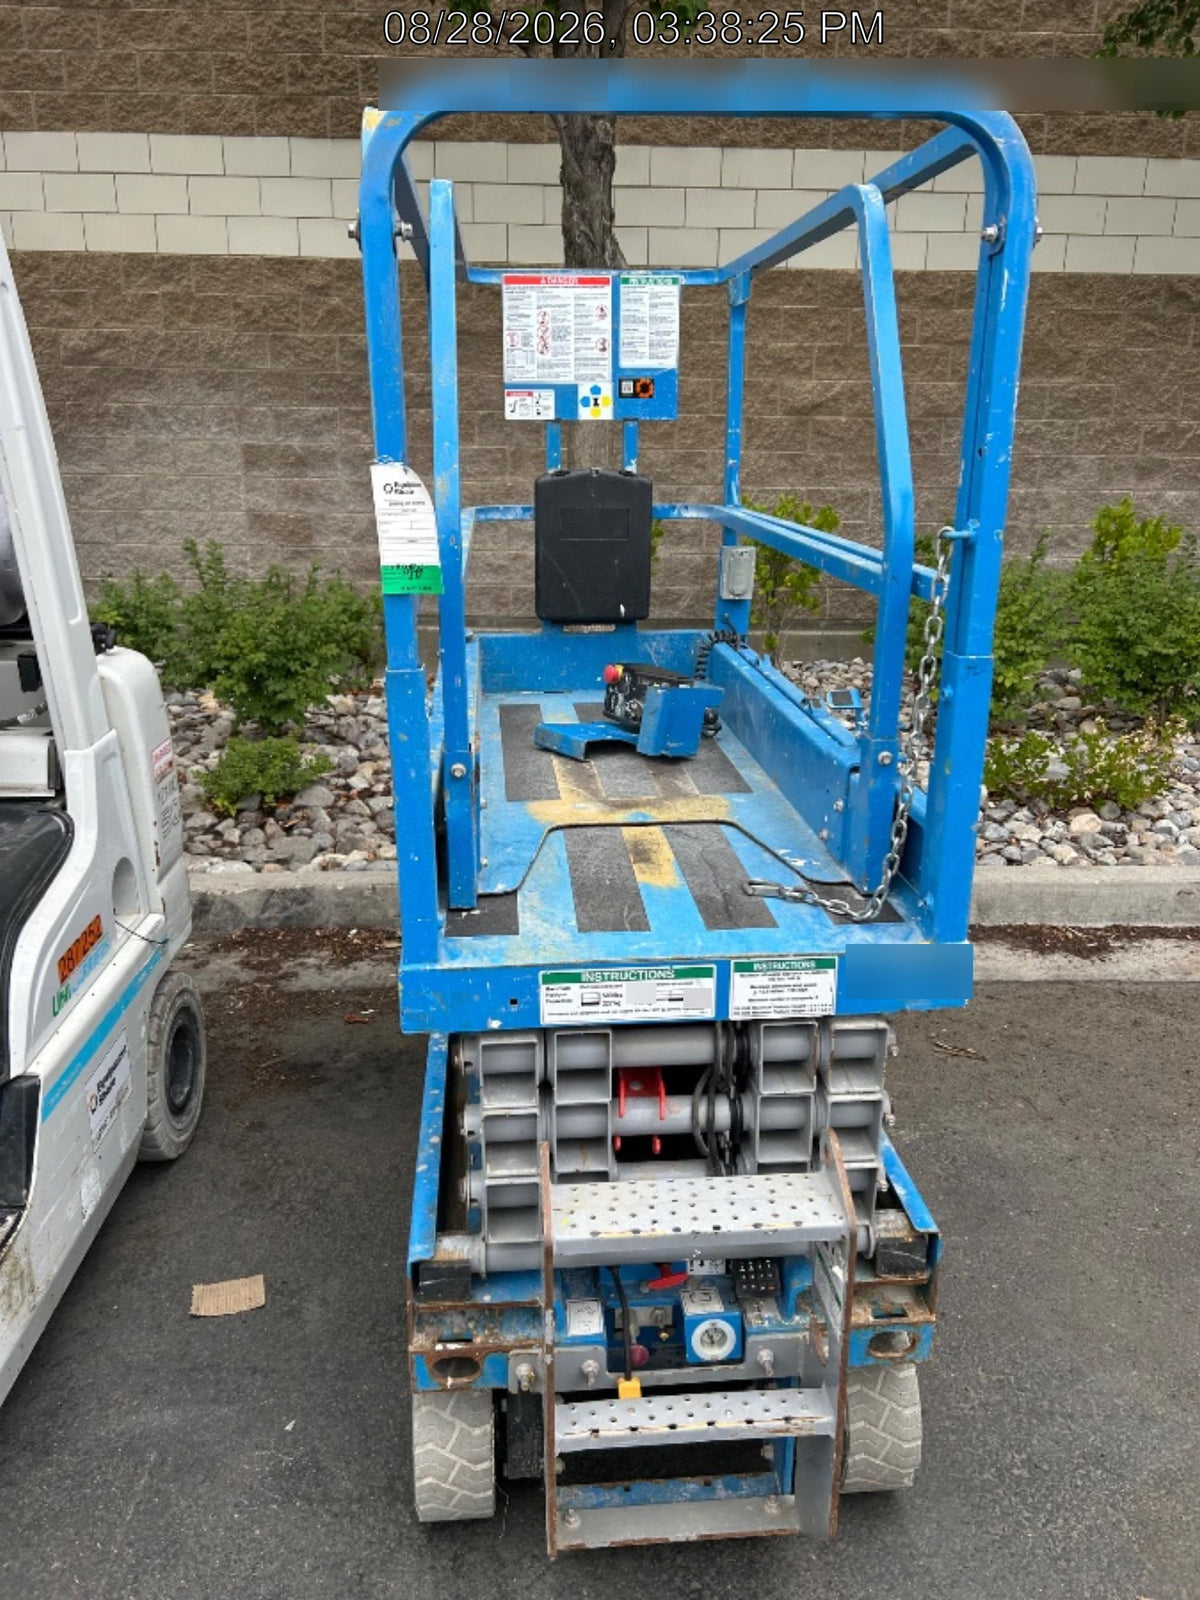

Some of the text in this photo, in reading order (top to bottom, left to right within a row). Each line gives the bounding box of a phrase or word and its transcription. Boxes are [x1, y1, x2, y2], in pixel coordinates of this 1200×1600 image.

[545, 277, 578, 285] DANGER
[753, 960, 816, 972] INSTRUCTIONS
[581, 968, 675, 983] INSTRUCTIONS
